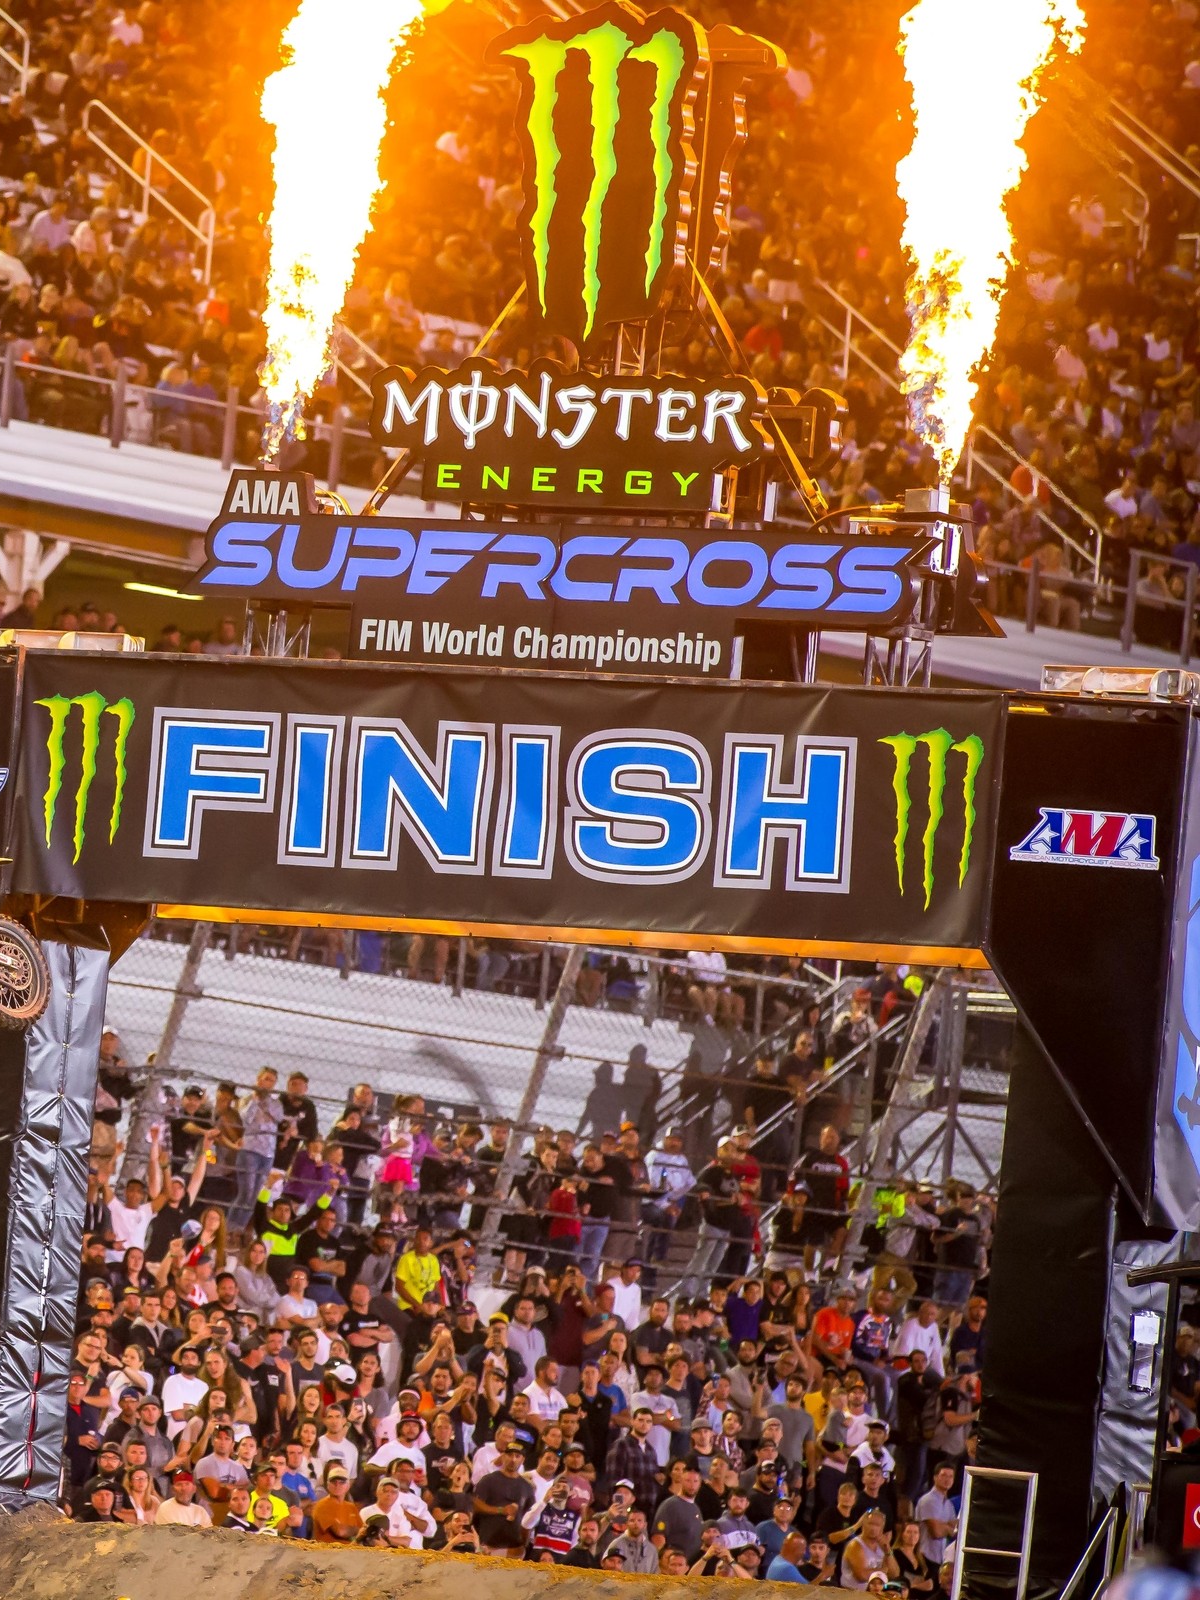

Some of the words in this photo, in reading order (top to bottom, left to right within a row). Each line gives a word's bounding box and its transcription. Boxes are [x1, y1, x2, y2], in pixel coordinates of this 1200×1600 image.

[382, 371, 753, 452] MONSTER
[228, 480, 300, 515] AMA
[436, 464, 699, 496] ENERGY
[201, 521, 912, 613] SUPERCROSS
[359, 618, 412, 652] FIM
[422, 621, 504, 657] World
[513, 626, 721, 672] Championship
[143, 707, 858, 893] FINISH
[1011, 808, 1158, 862] AMA
[1011, 853, 1051, 861] AMERICAN
[1051, 856, 1109, 865] MOTORCYCLIST
[1109, 859, 1158, 868] ASSOCIATION
